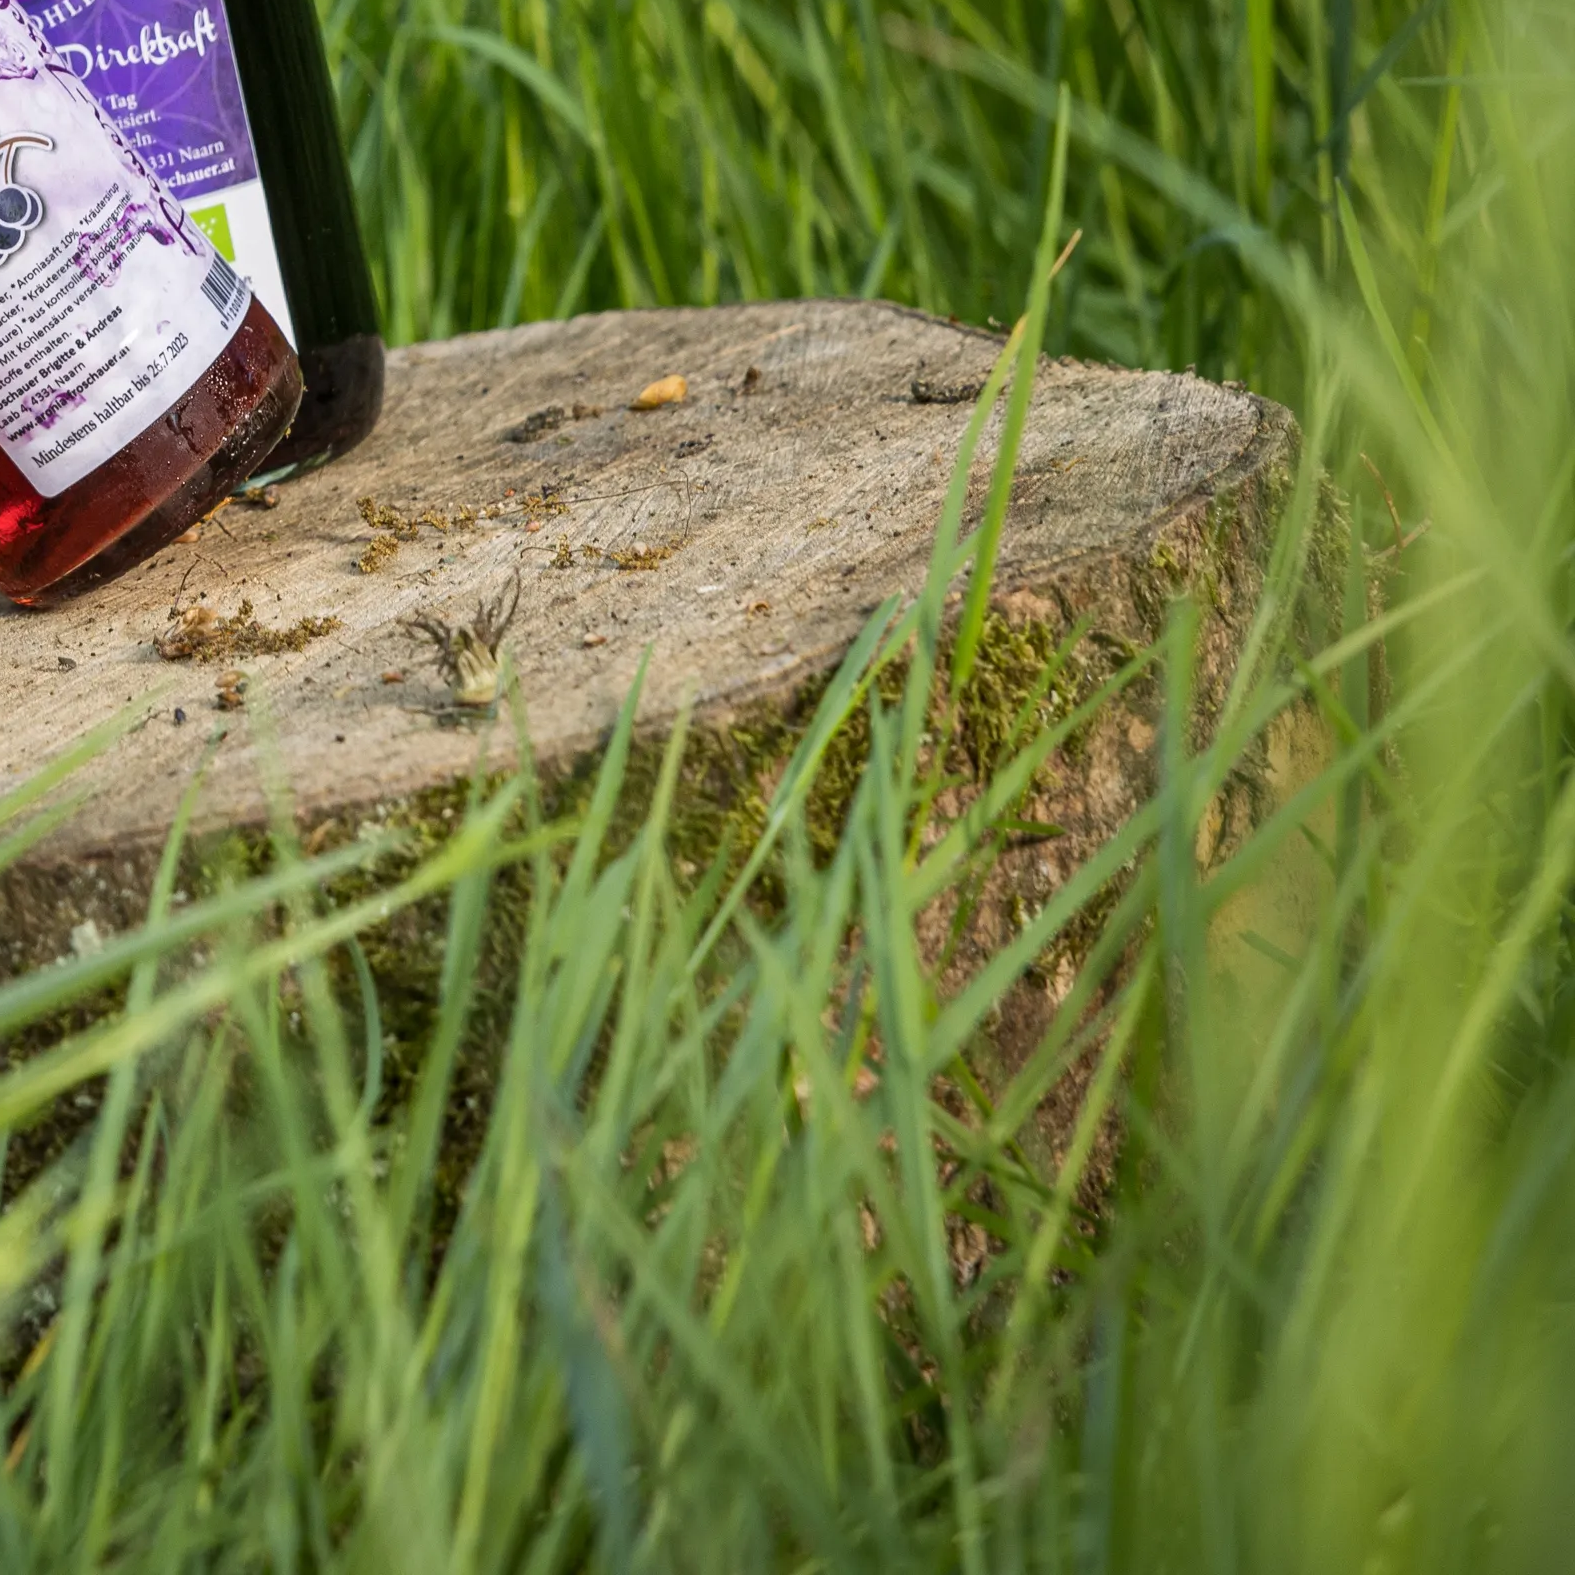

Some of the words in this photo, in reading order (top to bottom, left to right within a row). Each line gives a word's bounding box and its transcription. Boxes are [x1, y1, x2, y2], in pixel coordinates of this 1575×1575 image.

[56, 6, 219, 83] Direktsaft
[179, 137, 225, 165] Naarn
[44, 264, 92, 309] kontrolliert
[89, 218, 135, 266] biologischem
[16, 305, 73, 353] Kohlensäure
[73, 272, 109, 305] versetzt.
[107, 252, 127, 272] Kann
[24, 332, 71, 369] enthalten.
[38, 348, 76, 378] Brigitte
[75, 339, 86, 349] &
[85, 306, 122, 341] Andreas
[21, 401, 32, 413] 4,
[31, 385, 57, 405] 4331
[54, 362, 85, 387] Naarn
[31, 420, 97, 468] Mindestens
[93, 388, 134, 424] haltbar
[131, 374, 150, 391] bis
[147, 332, 188, 378] 26.7.2023
